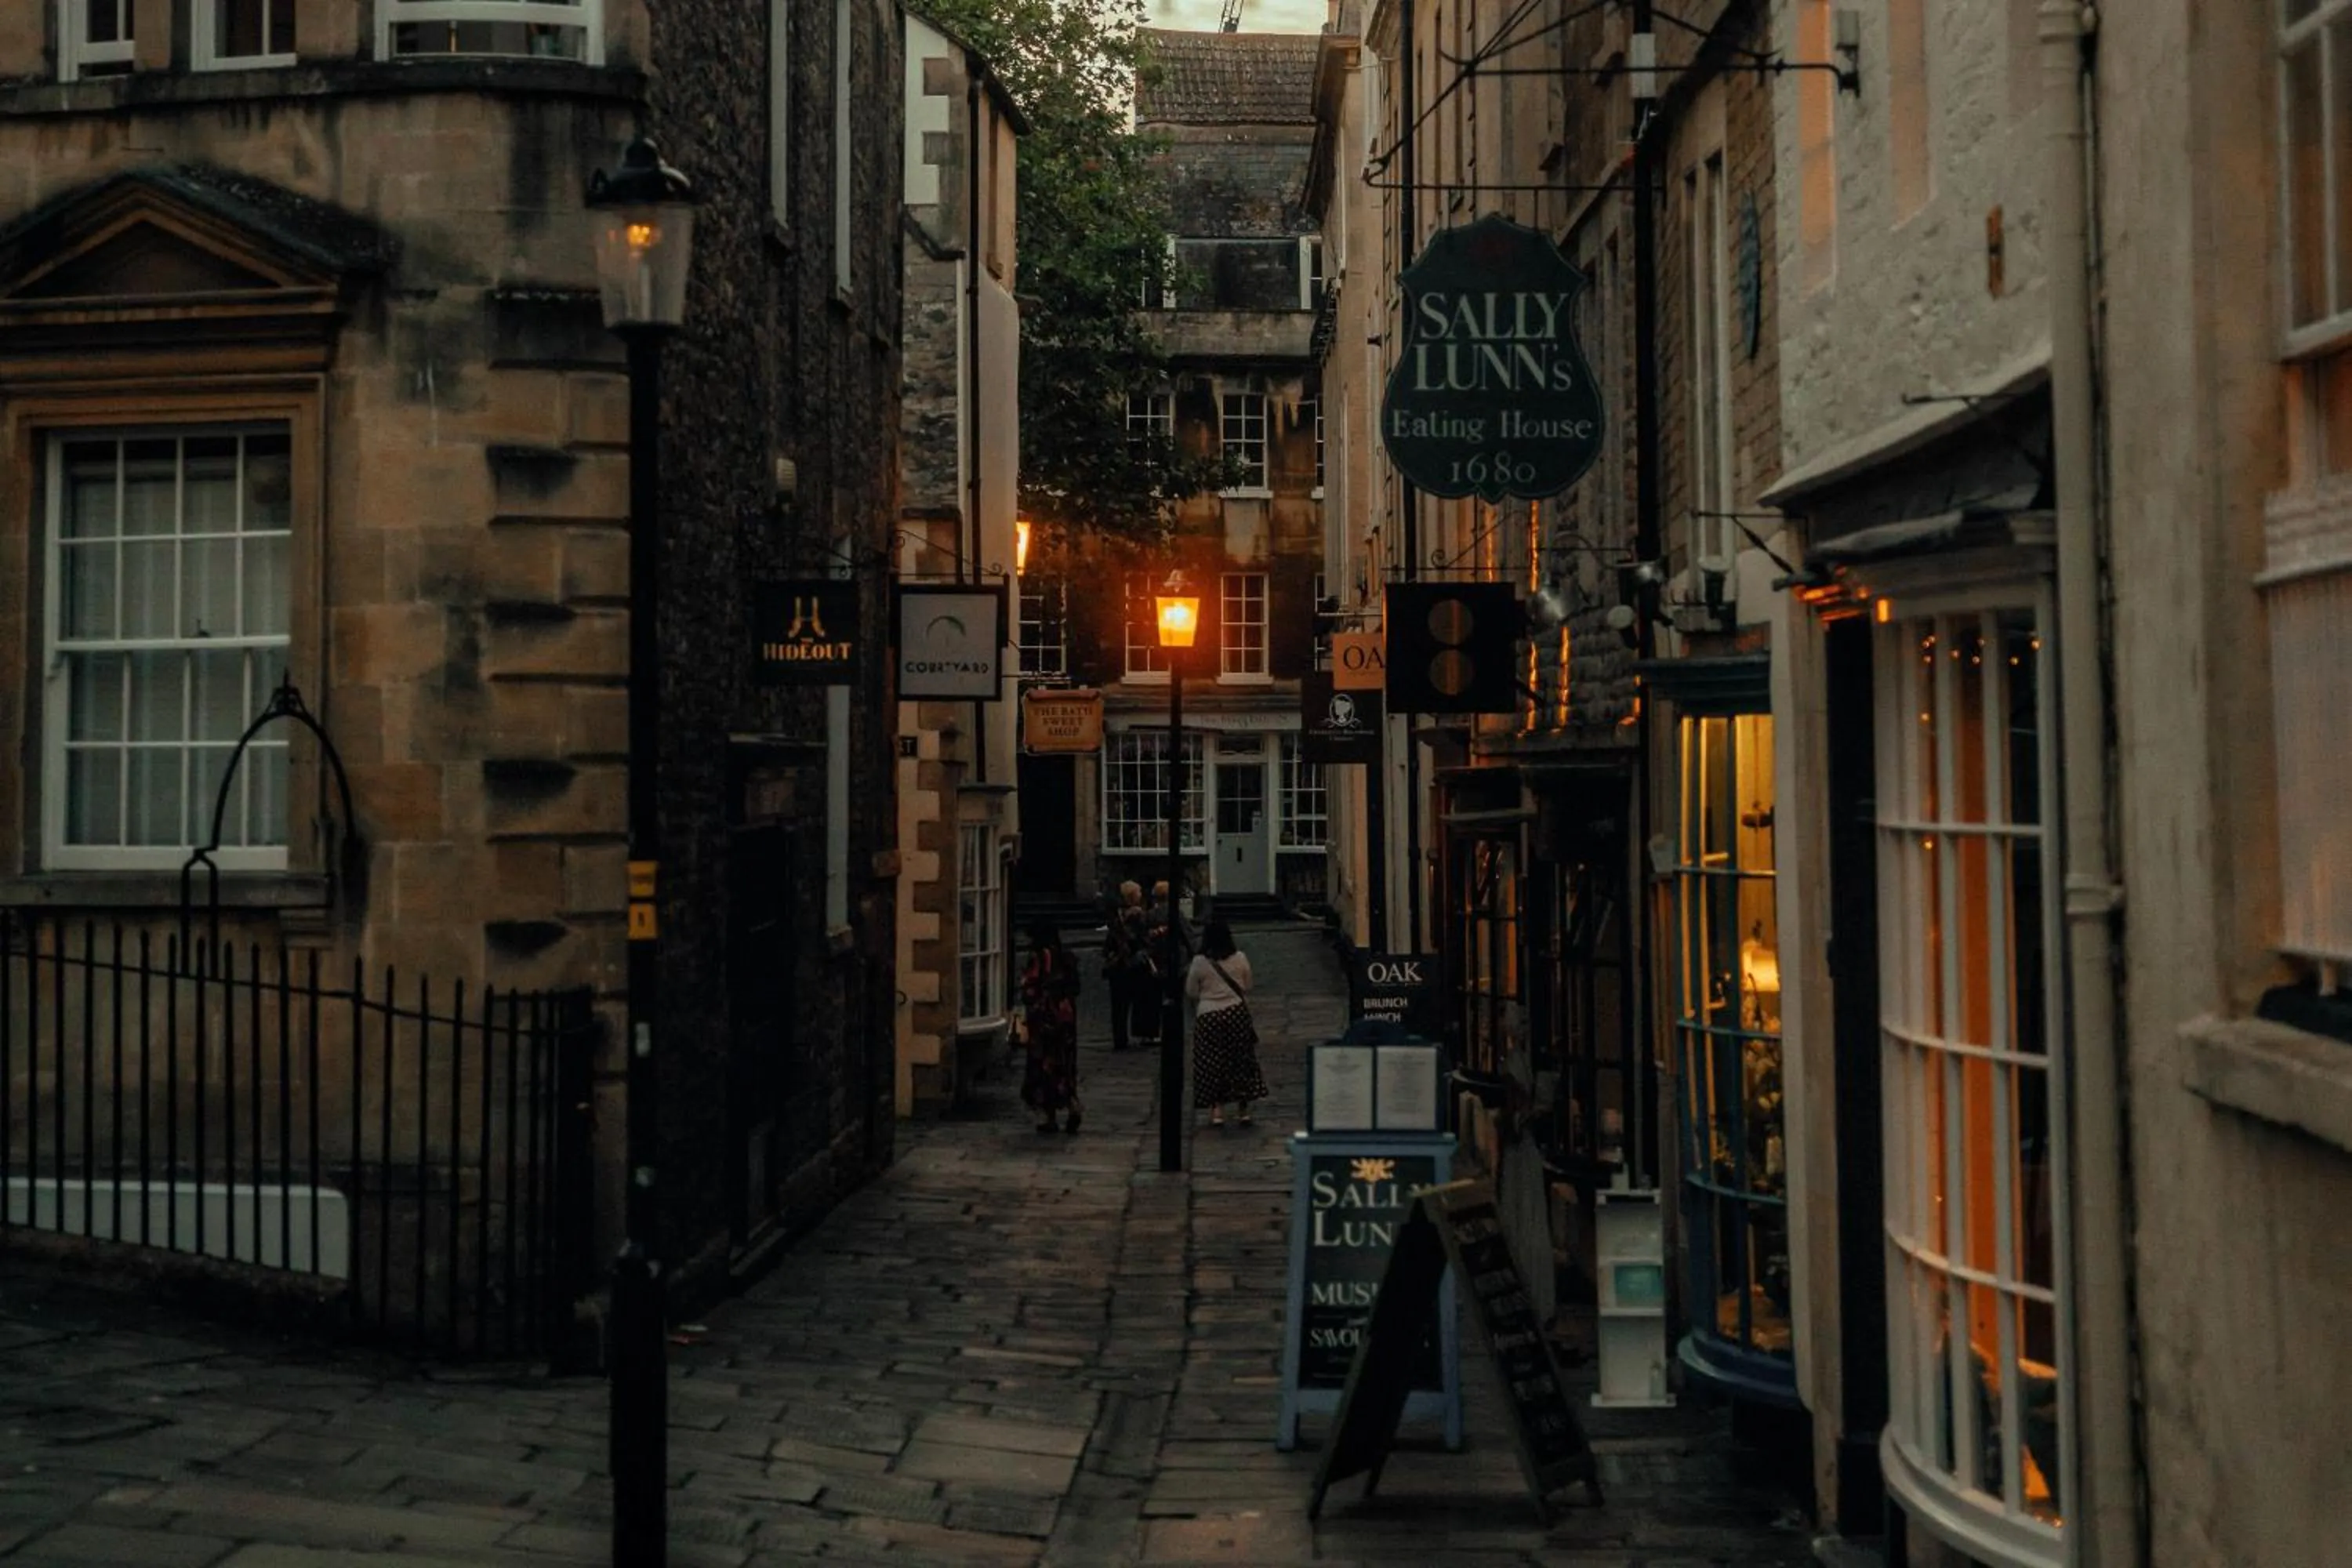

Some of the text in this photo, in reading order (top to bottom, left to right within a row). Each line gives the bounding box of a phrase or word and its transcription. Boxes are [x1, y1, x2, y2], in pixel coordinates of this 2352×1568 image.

[1419, 291, 1569, 340] SALLY
[1392, 409, 1592, 443] Eating House
[1450, 450, 1536, 484] 1680
[906, 662, 989, 673] COURTYARD
[1343, 645, 1385, 670] OA
[1367, 961, 1423, 983] OAK
[1363, 996, 1408, 1009] BRUNCH
[1313, 1210, 1393, 1247] LUN
